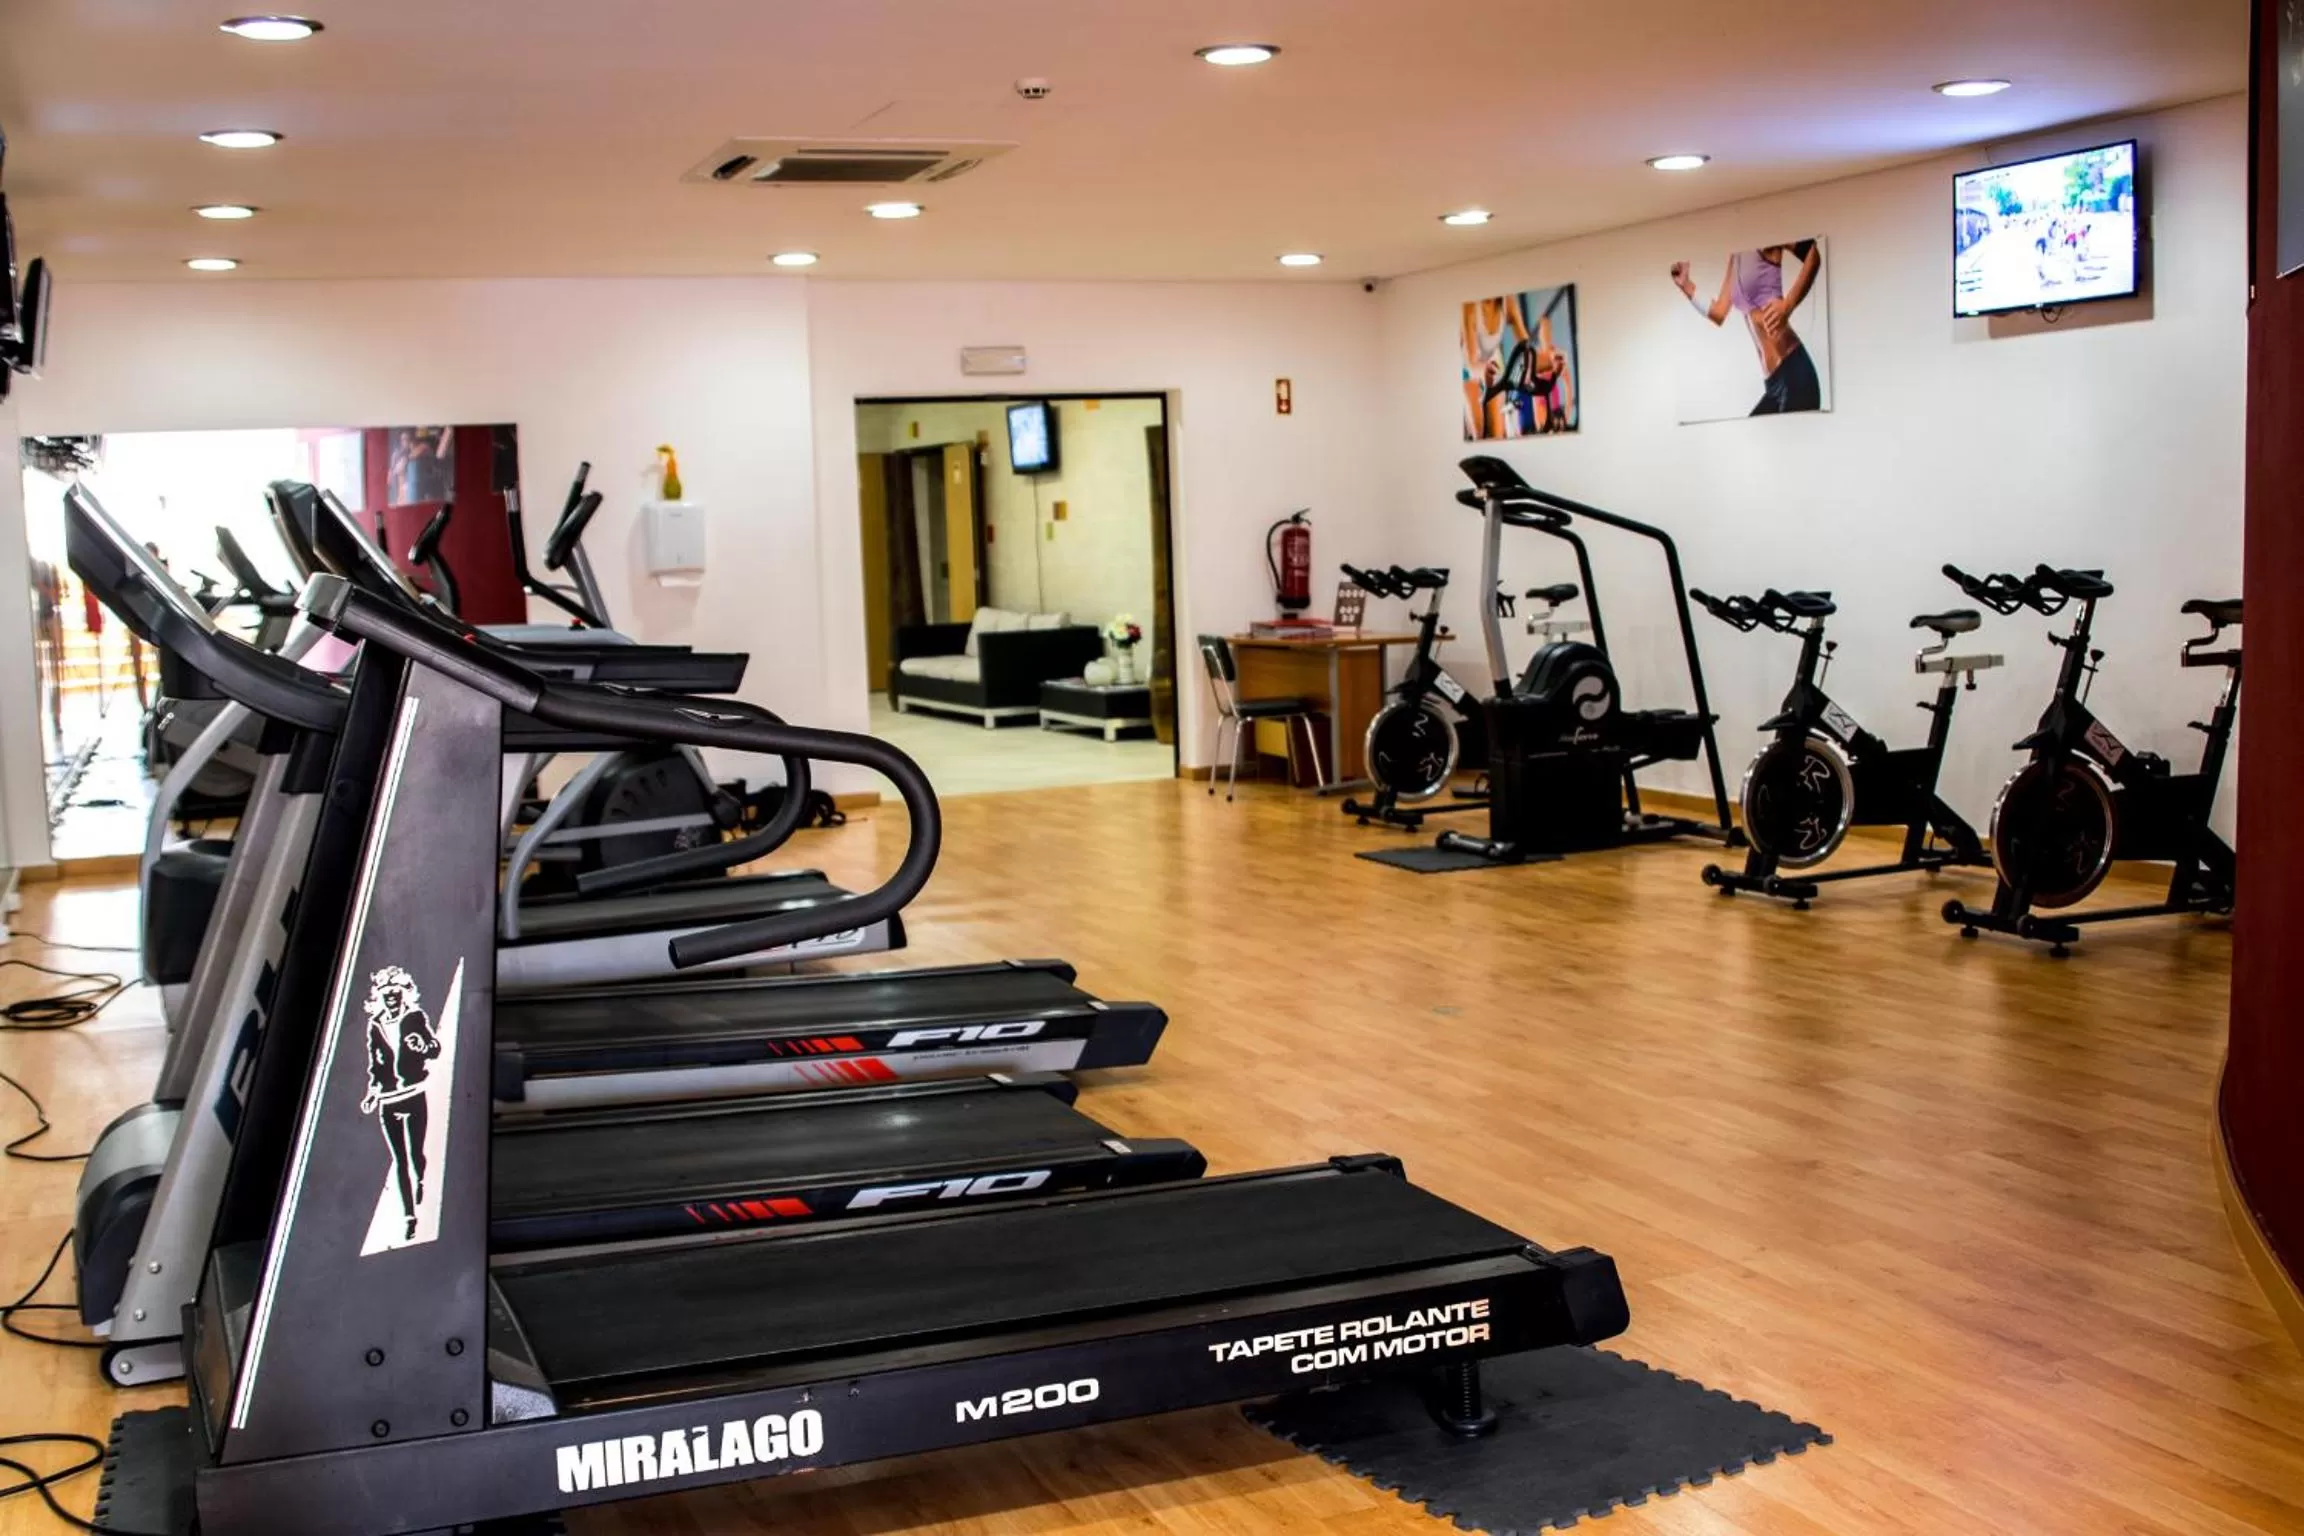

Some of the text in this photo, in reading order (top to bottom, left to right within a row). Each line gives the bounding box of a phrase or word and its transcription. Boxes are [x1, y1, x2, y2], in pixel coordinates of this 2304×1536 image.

[887, 1020, 1046, 1047] F10
[846, 1170, 1051, 1209] F10
[1208, 1298, 1490, 1363] TAPETE ROLANTE
[1291, 1322, 1490, 1374] COM MOTOR
[955, 1378, 1100, 1424] M200
[556, 1409, 824, 1494] MIRALAGO
